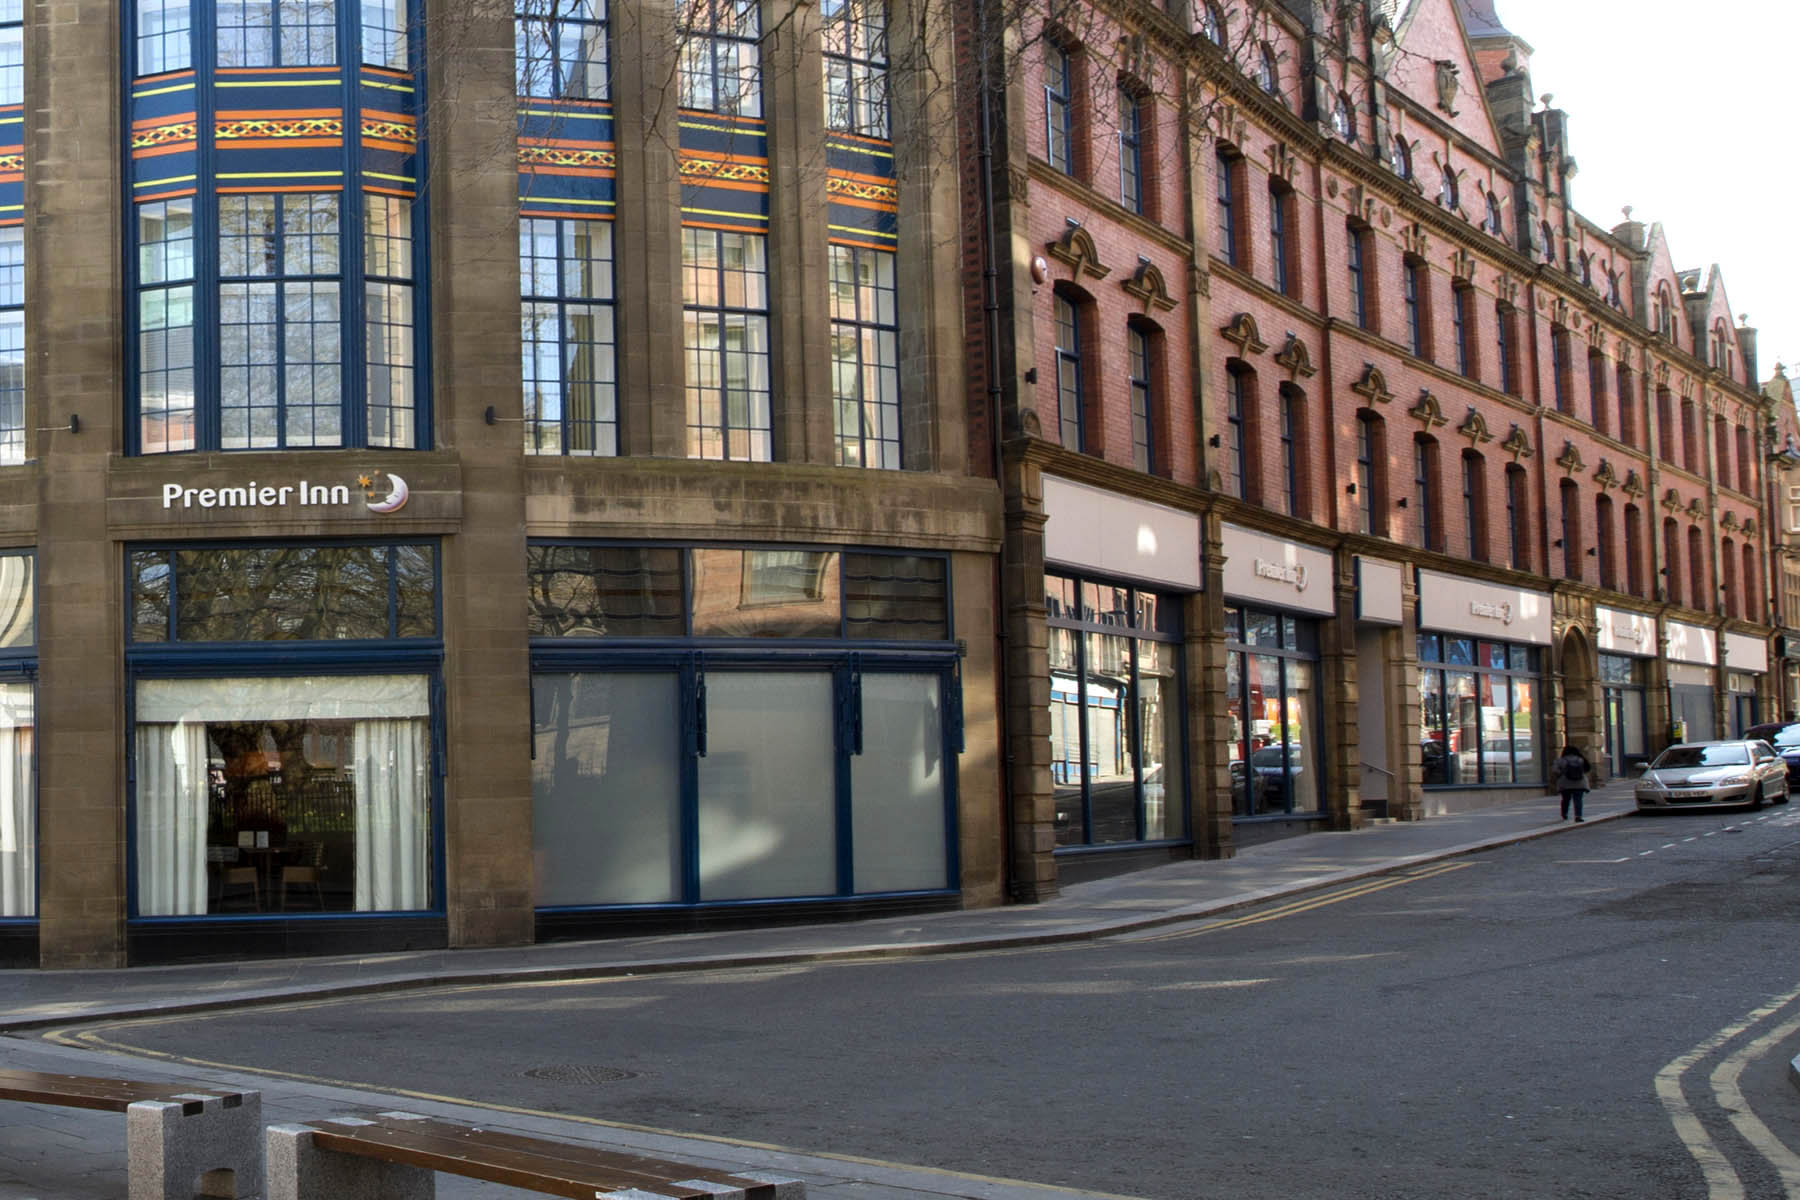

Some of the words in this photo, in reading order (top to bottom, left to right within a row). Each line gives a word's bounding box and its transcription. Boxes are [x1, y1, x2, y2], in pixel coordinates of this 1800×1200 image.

[162, 481, 294, 509] Premier
[299, 480, 349, 505] Inn
[1255, 558, 1286, 581] Premier
